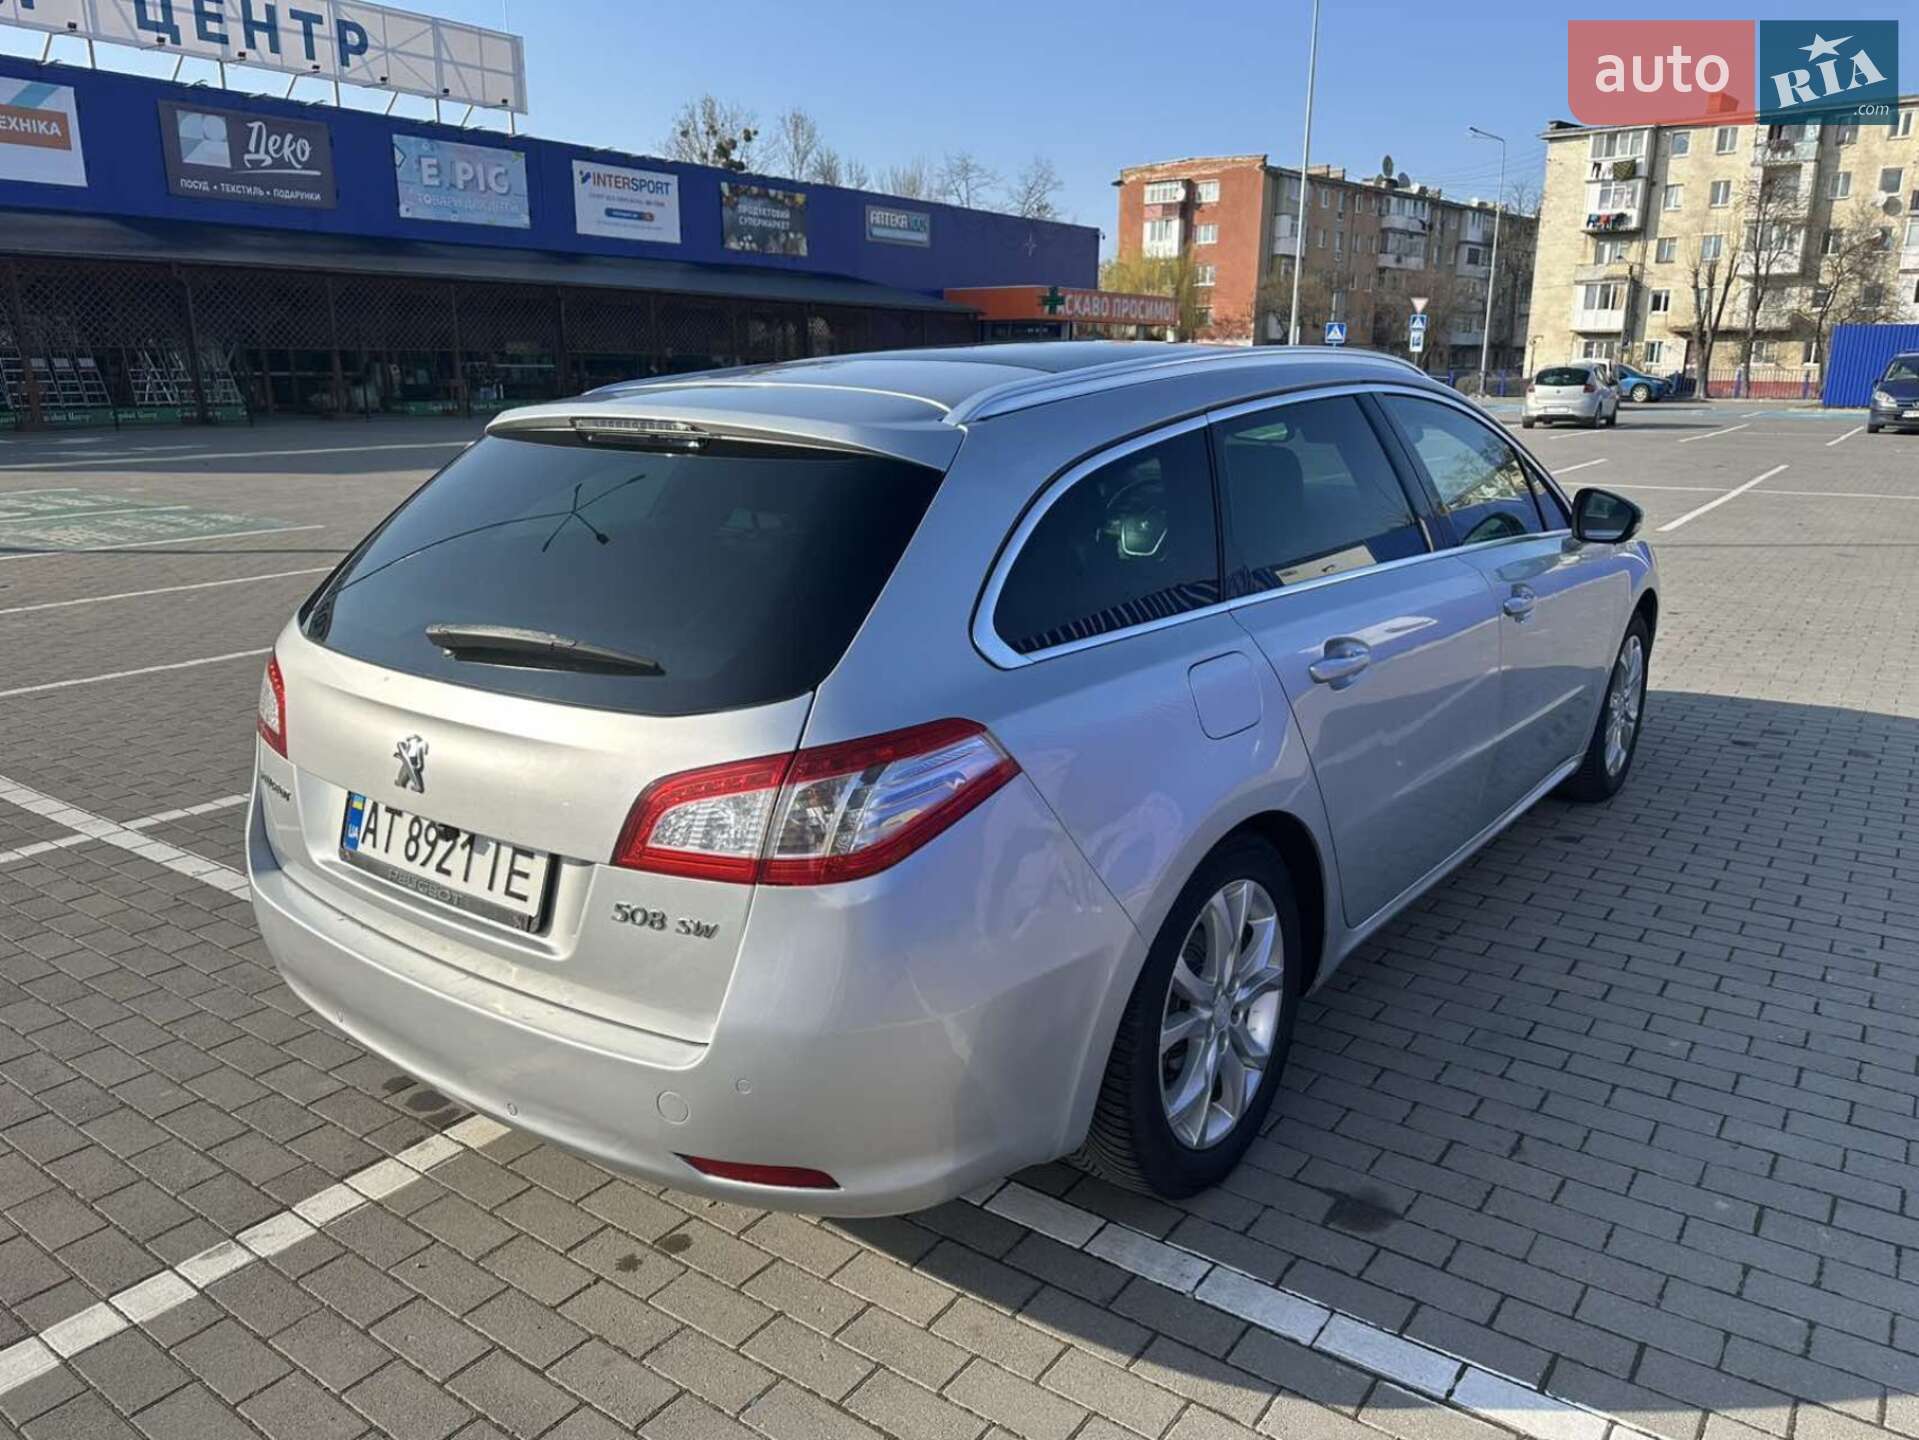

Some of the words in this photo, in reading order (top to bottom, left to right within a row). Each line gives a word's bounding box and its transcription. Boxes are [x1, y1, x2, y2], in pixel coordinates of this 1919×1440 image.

[134, 0, 369, 67] ЦЕНТР
[180, 178, 210, 191] ПОСУД
[220, 183, 264, 197] ТЕКСТИЛЬ
[273, 188, 322, 201] ПОДАРУНКИ
[592, 171, 673, 196] INTERSPORT
[361, 801, 402, 853] AT
[404, 815, 476, 883] 8921
[611, 903, 667, 931] 508
[675, 919, 720, 939] SW
